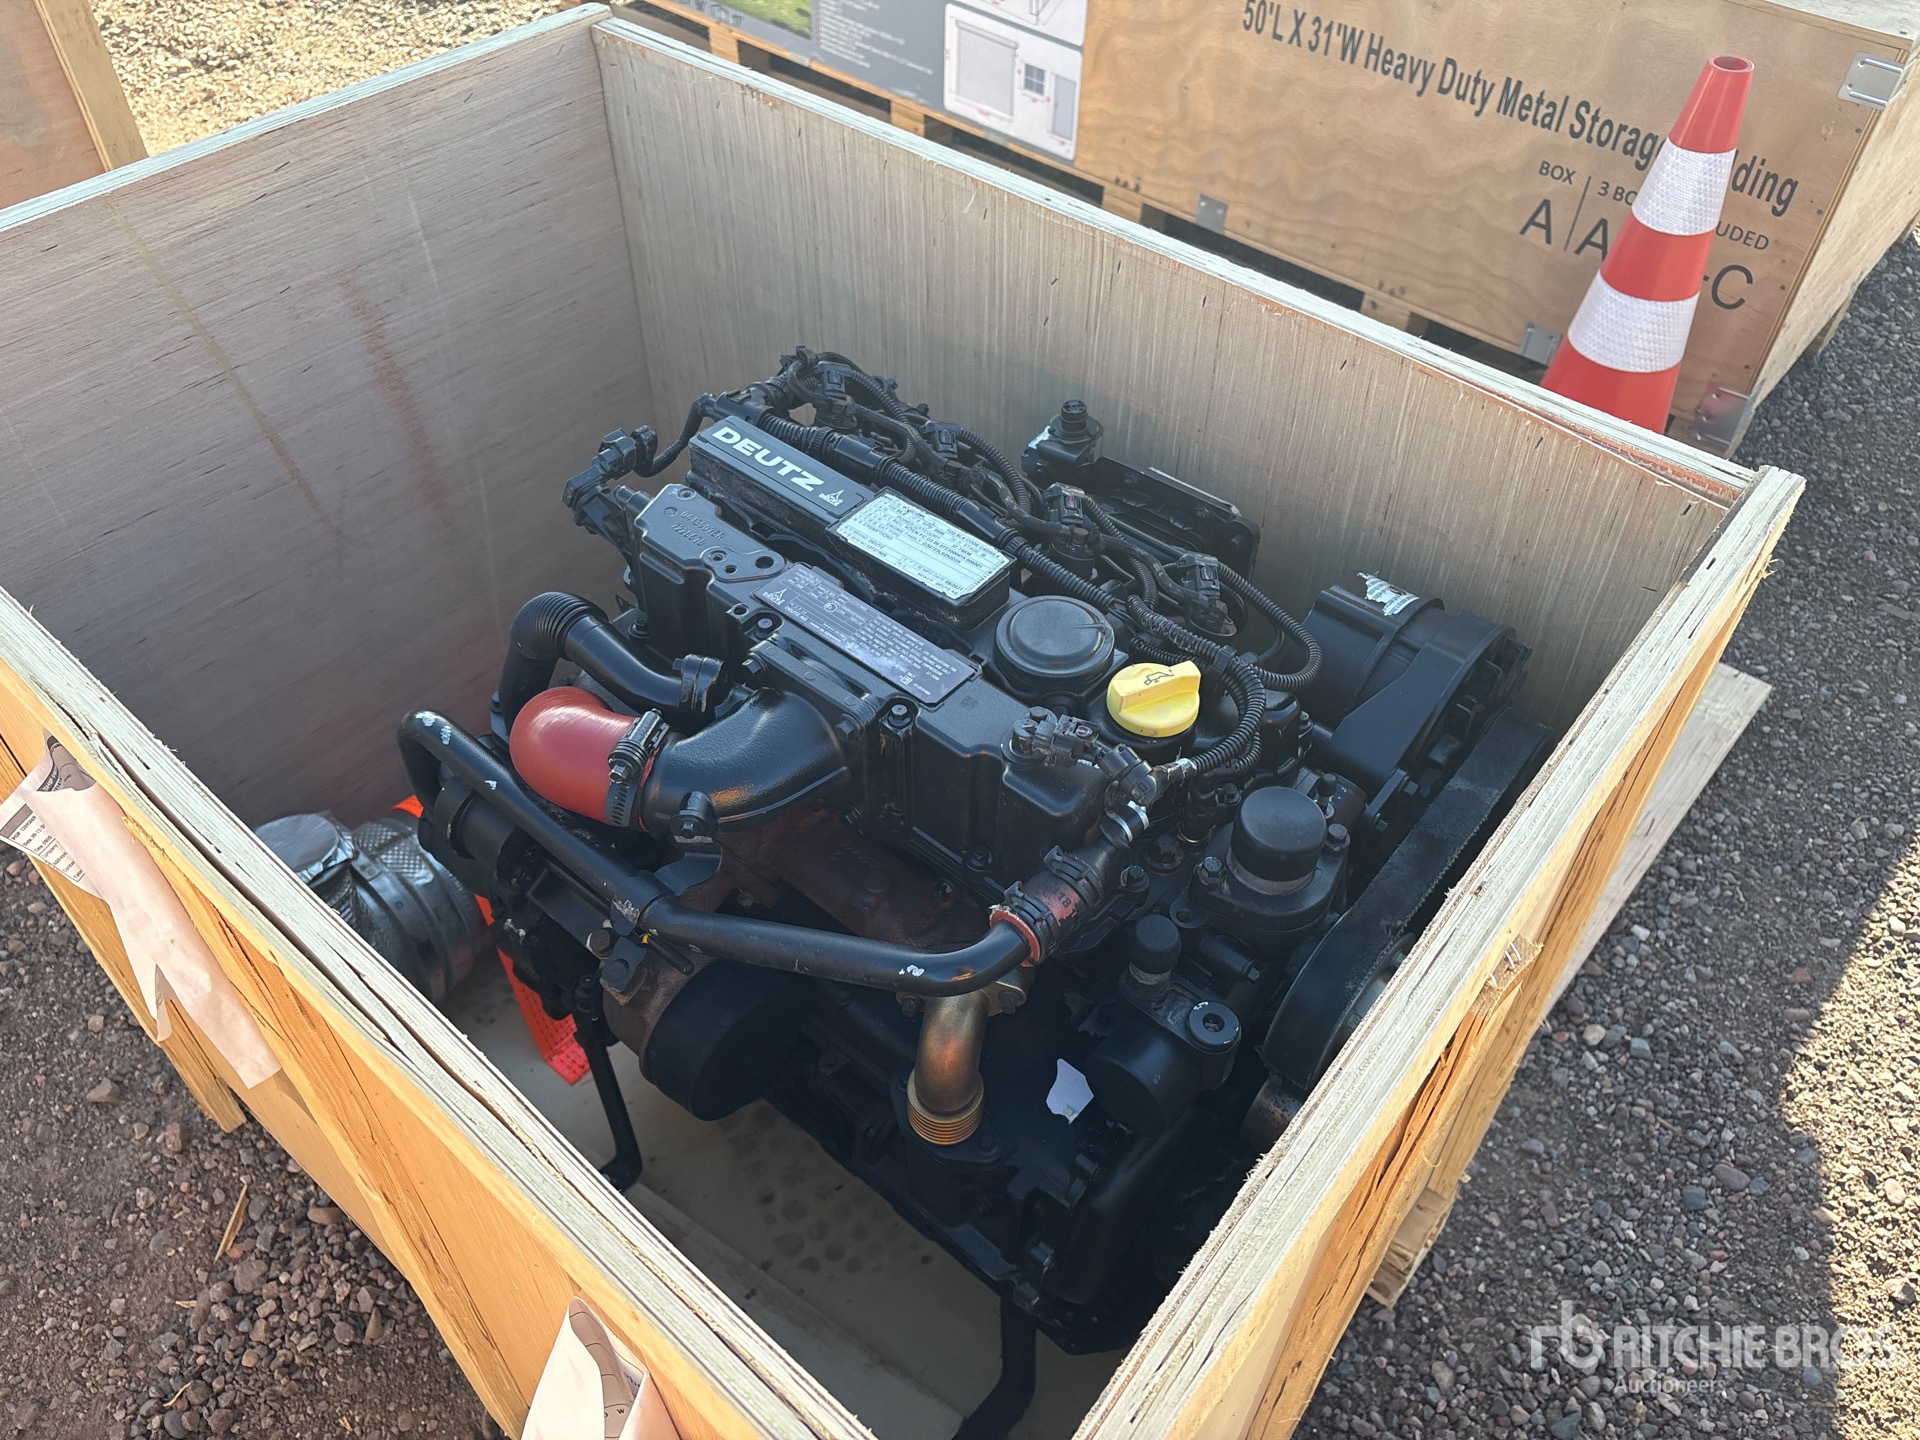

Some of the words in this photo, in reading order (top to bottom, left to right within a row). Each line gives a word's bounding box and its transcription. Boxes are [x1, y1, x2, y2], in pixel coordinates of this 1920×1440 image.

[1287, 9, 1307, 47] X
[1308, 16, 1365, 64] 31'W
[1363, 33, 1437, 97] Heavy
[1437, 56, 1495, 117] Duty
[1496, 76, 1570, 133] Metal
[1569, 100, 1667, 172] Storag
[1731, 148, 1799, 217] ding
[1539, 161, 1577, 185] BOX
[1519, 198, 1552, 246] A
[1597, 181, 1610, 197] 3
[1714, 220, 1770, 250] UDED
[712, 426, 825, 492] DEUTZ
[867, 538, 885, 549] DEUTZ
[934, 581, 950, 592] DEUTZ
[783, 606, 801, 616] DEUTZ
